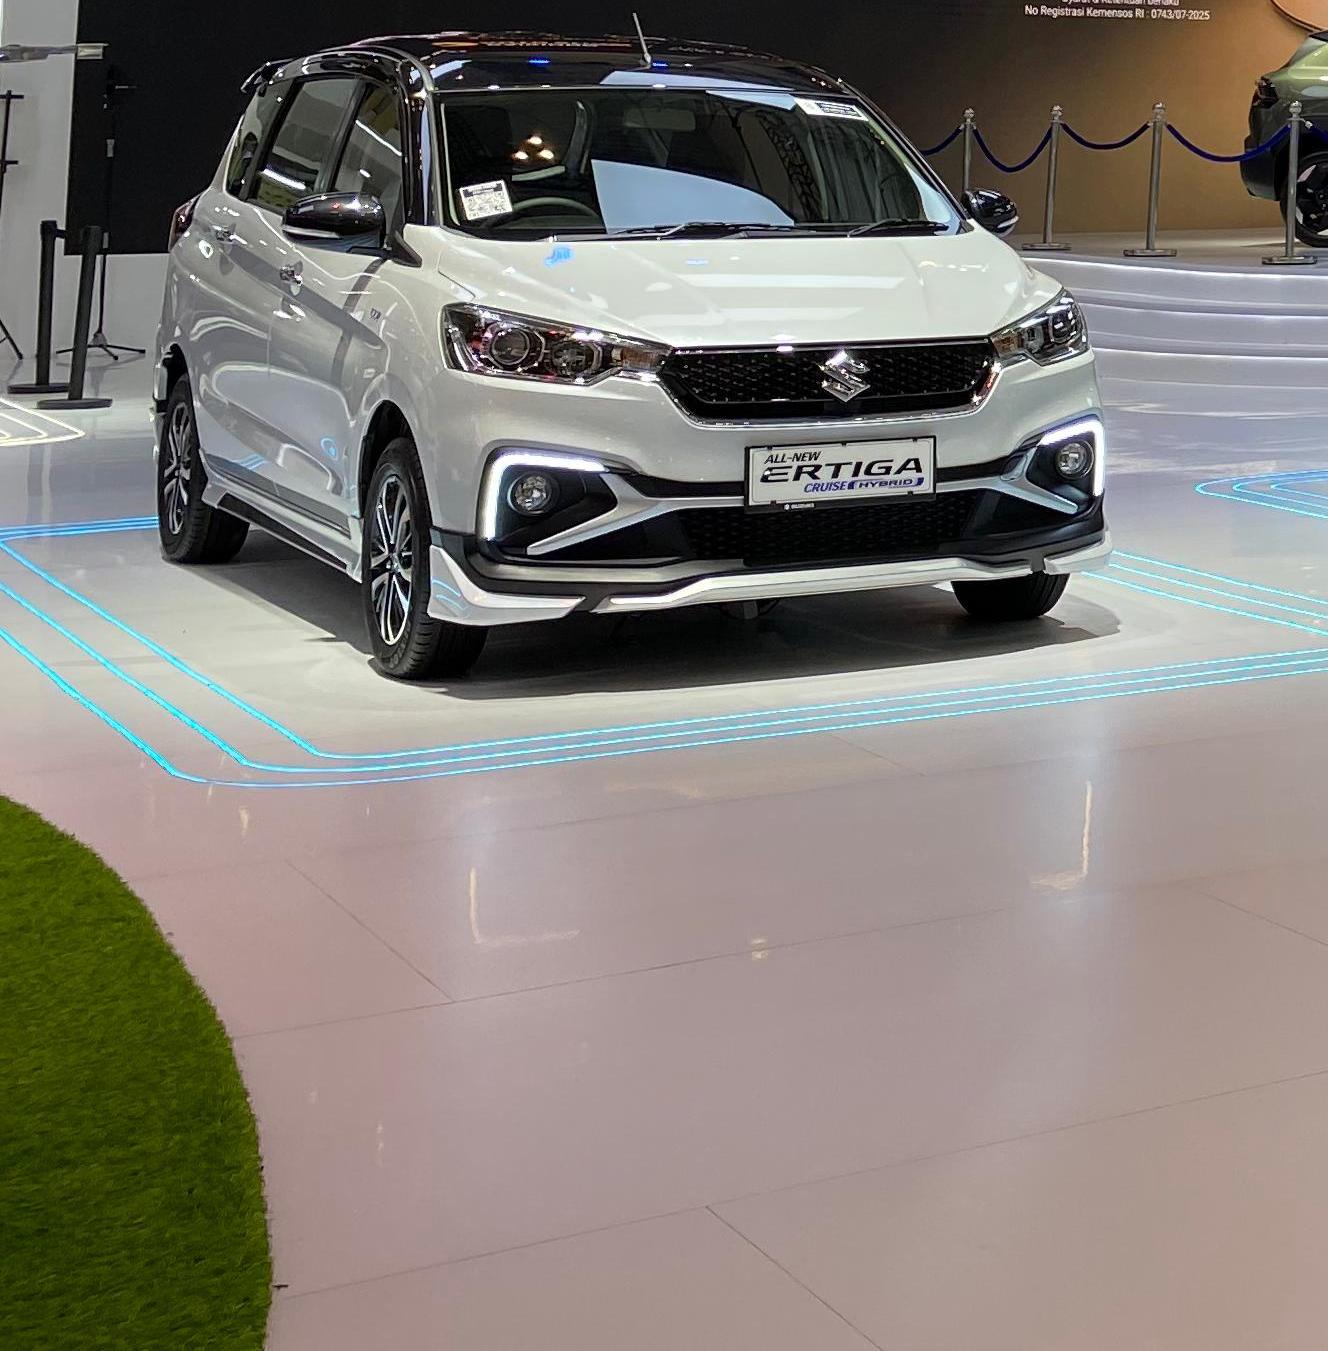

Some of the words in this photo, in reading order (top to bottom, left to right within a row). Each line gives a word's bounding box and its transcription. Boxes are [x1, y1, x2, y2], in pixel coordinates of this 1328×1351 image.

[1025, 5, 1039, 16] No
[1040, 5, 1084, 19] Registrasi
[1086, 7, 1133, 19] Kemensos
[1135, 10, 1144, 18] RI
[764, 451, 822, 465] ALL-NEW
[760, 457, 923, 483] ERTIGA
[804, 481, 849, 493] CRUISE
[857, 478, 914, 489] HYBRID
